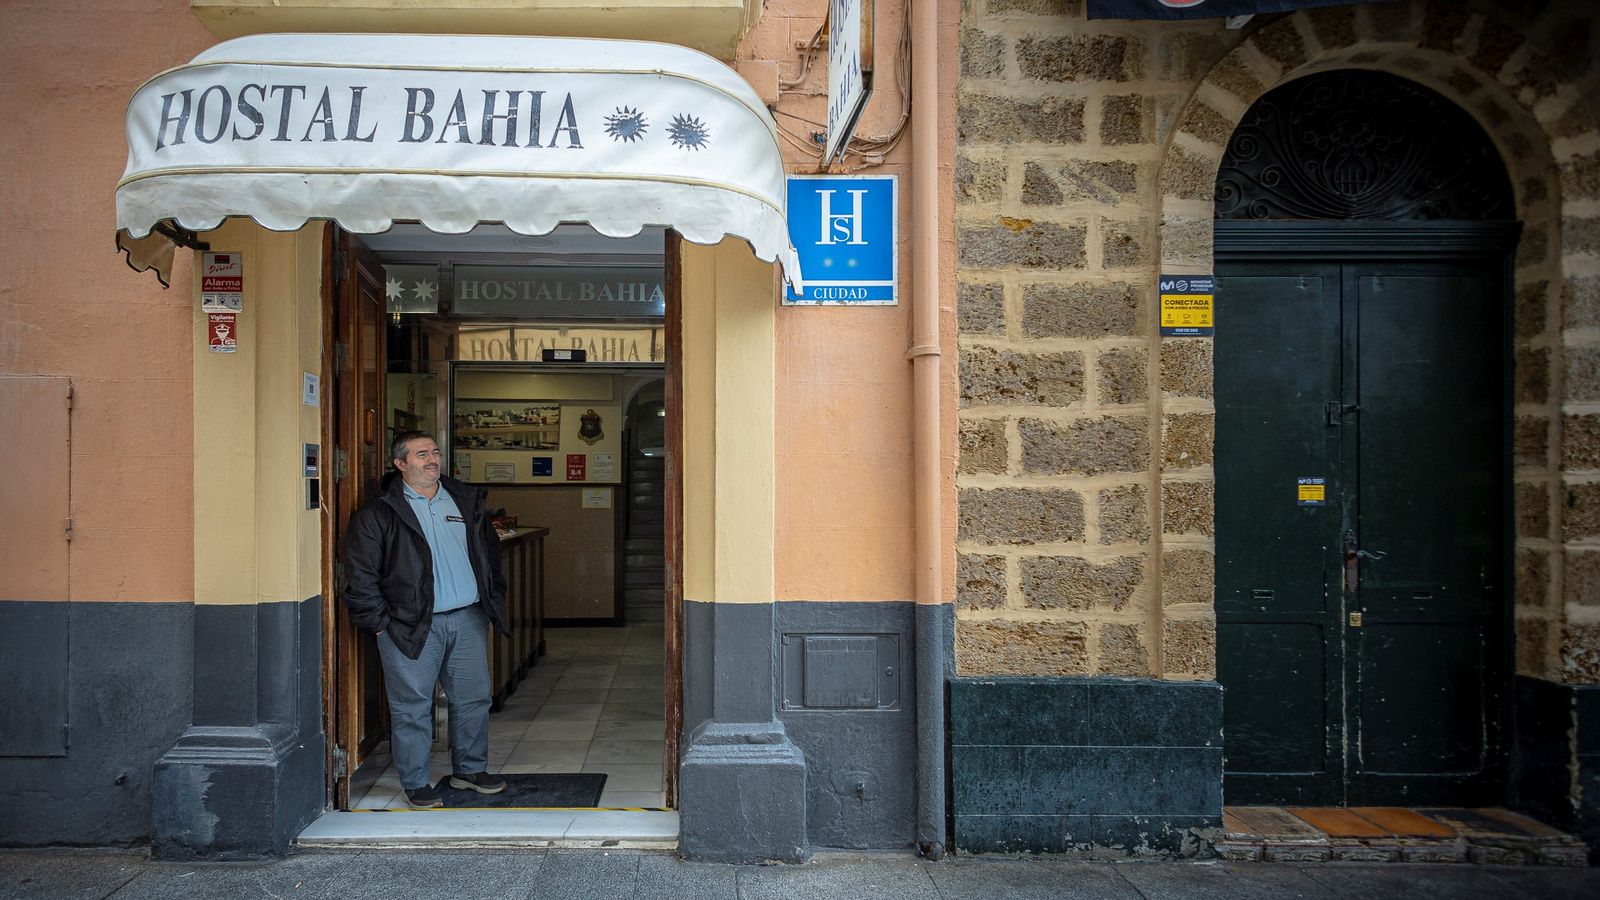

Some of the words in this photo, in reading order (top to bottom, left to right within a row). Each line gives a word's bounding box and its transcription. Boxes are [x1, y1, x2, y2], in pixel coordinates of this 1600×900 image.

[155, 84, 378, 152] HOSTAL
[398, 87, 585, 150] BAHIA
[204, 278, 240, 286] Alarma
[461, 281, 571, 300] HOSTAL
[579, 282, 664, 302] BAHIA
[813, 287, 868, 299] CIUDAD
